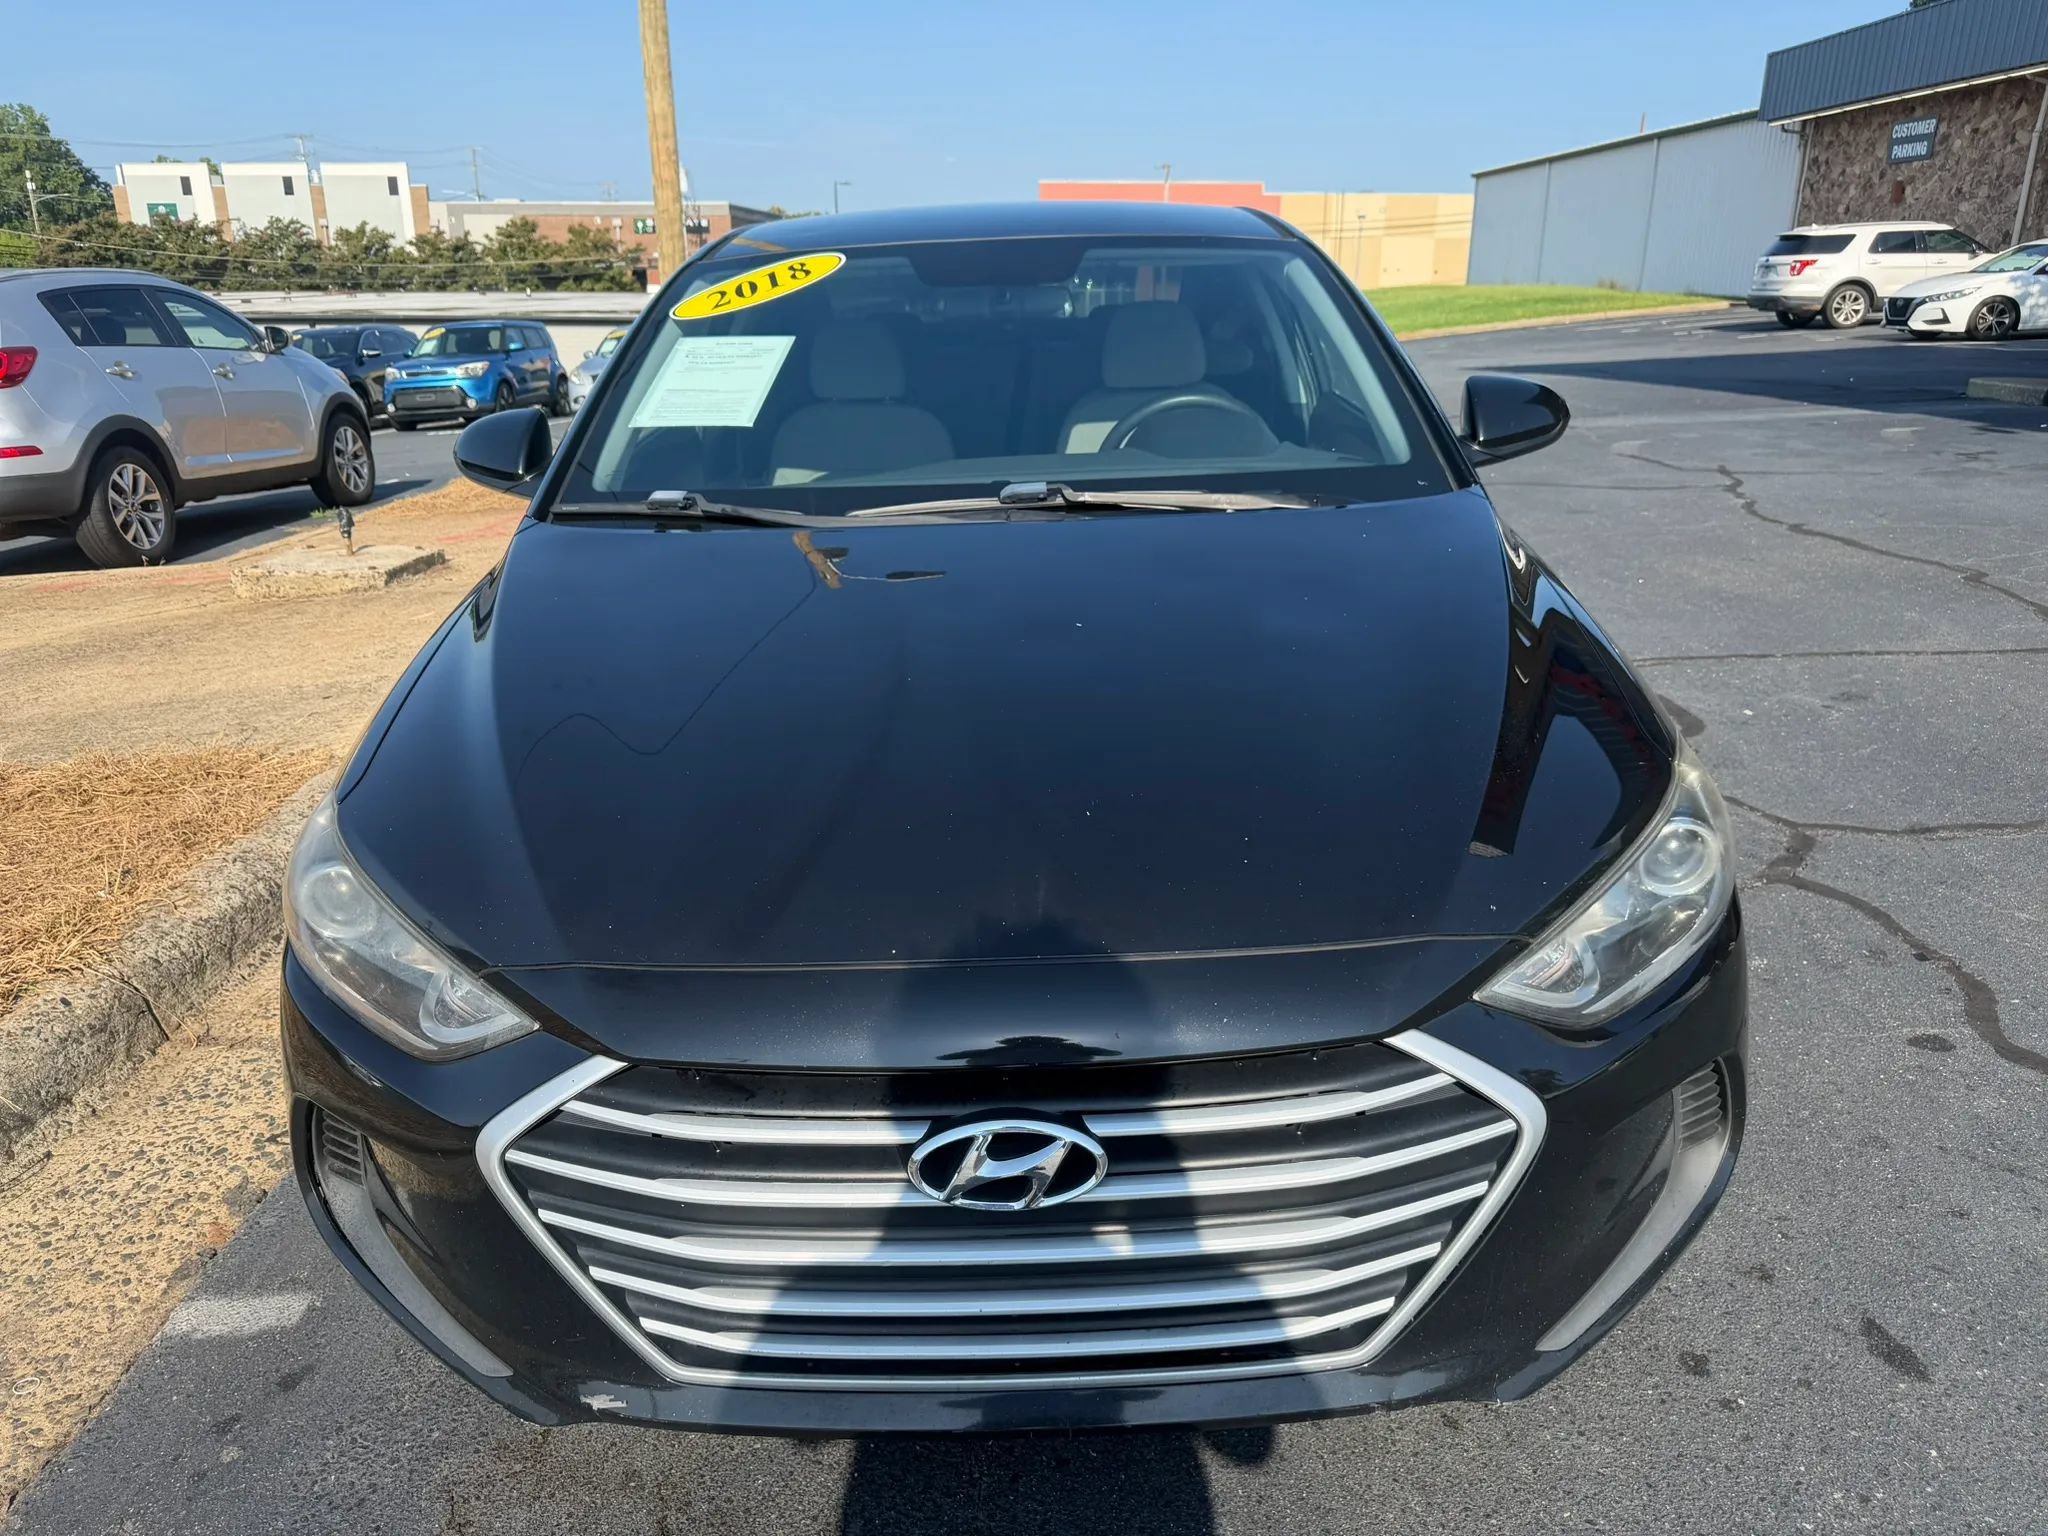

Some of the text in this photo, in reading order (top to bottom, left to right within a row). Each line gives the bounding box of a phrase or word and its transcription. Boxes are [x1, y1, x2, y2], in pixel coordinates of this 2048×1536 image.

[1892, 118, 1936, 138] CUSTOMER
[1891, 141, 1928, 159] PARKING
[706, 262, 812, 310] 2018
